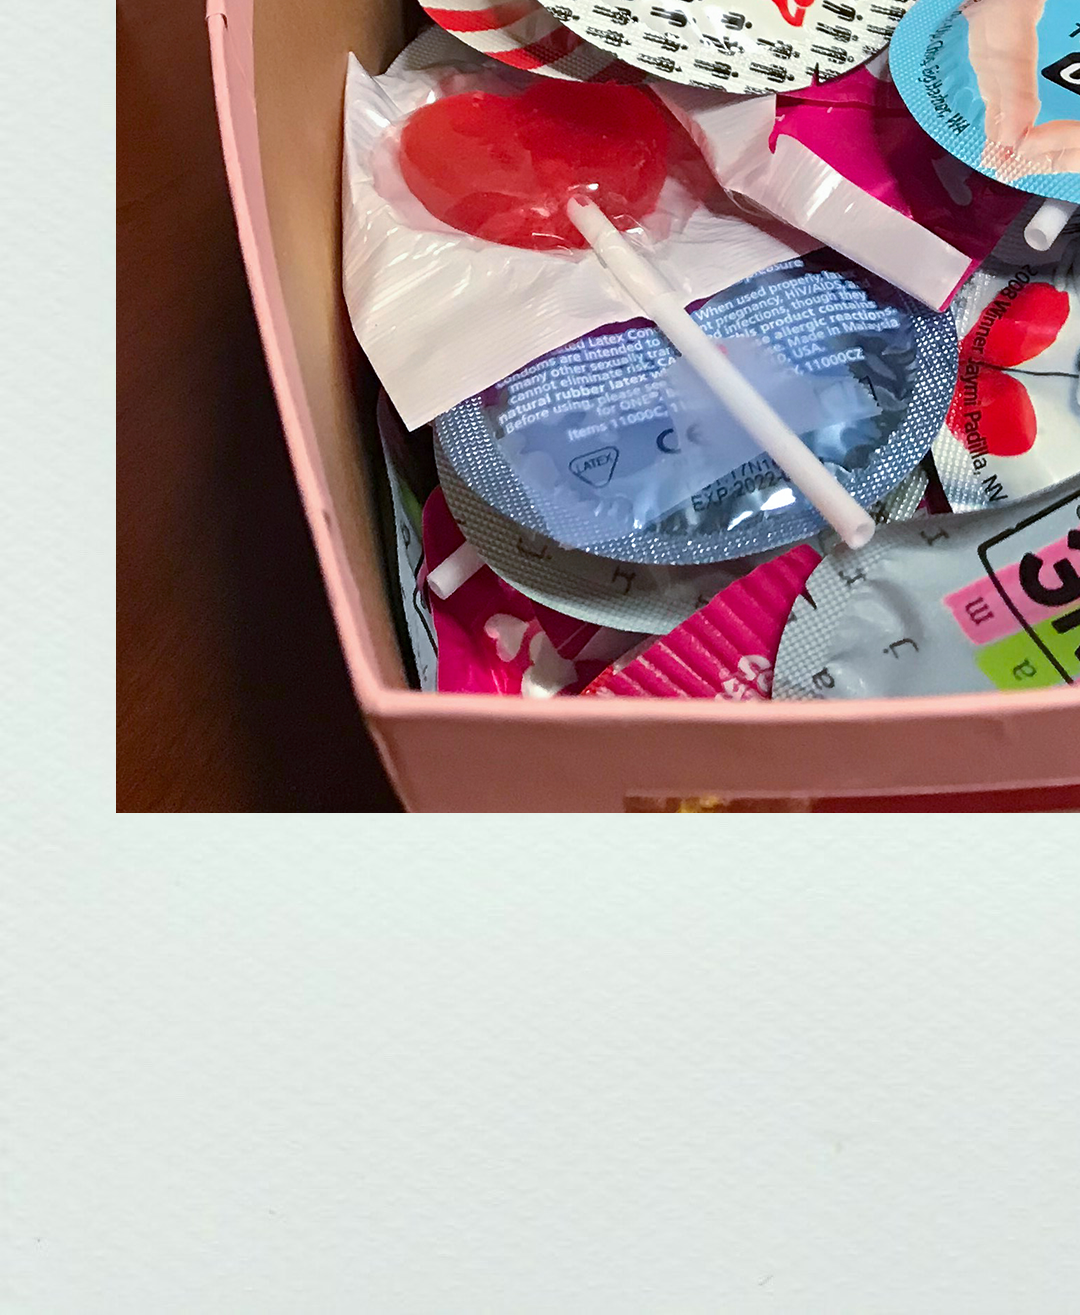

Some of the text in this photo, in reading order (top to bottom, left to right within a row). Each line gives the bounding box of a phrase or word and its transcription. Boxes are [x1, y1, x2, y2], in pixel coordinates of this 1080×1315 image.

[947, 112, 970, 136] WA
[695, 301, 734, 320] When
[736, 286, 766, 305] used
[768, 273, 823, 295] properly,
[715, 296, 784, 328] pregnancy,
[785, 280, 846, 300] HIV/AIDS,
[725, 305, 790, 335] infections,
[791, 292, 839, 310] though
[838, 290, 867, 302] they
[760, 307, 815, 333] product
[819, 301, 878, 314] contains
[774, 317, 827, 340] allergic
[828, 306, 898, 323] reactions.
[787, 330, 826, 347] Made
[827, 325, 841, 336] in
[842, 318, 900, 332] Malaysia
[560, 353, 582, 364] are
[584, 340, 643, 360] intended
[645, 338, 660, 348] to
[588, 334, 624, 347] Latex
[793, 343, 826, 358] USA.
[508, 370, 547, 393] many
[551, 365, 586, 378] other
[590, 353, 643, 372] sexually
[805, 347, 865, 371] 11000CZ
[510, 381, 558, 404] cannot
[560, 368, 622, 387] eliminate
[963, 264, 1039, 502] 2008 Winner Jaymi Padilla, NV
[499, 374, 646, 425] natural rubber latex
[505, 409, 549, 434] Before
[598, 387, 640, 406] please
[596, 405, 616, 416] for
[568, 423, 608, 441] Items
[576, 453, 612, 473] LATEX
